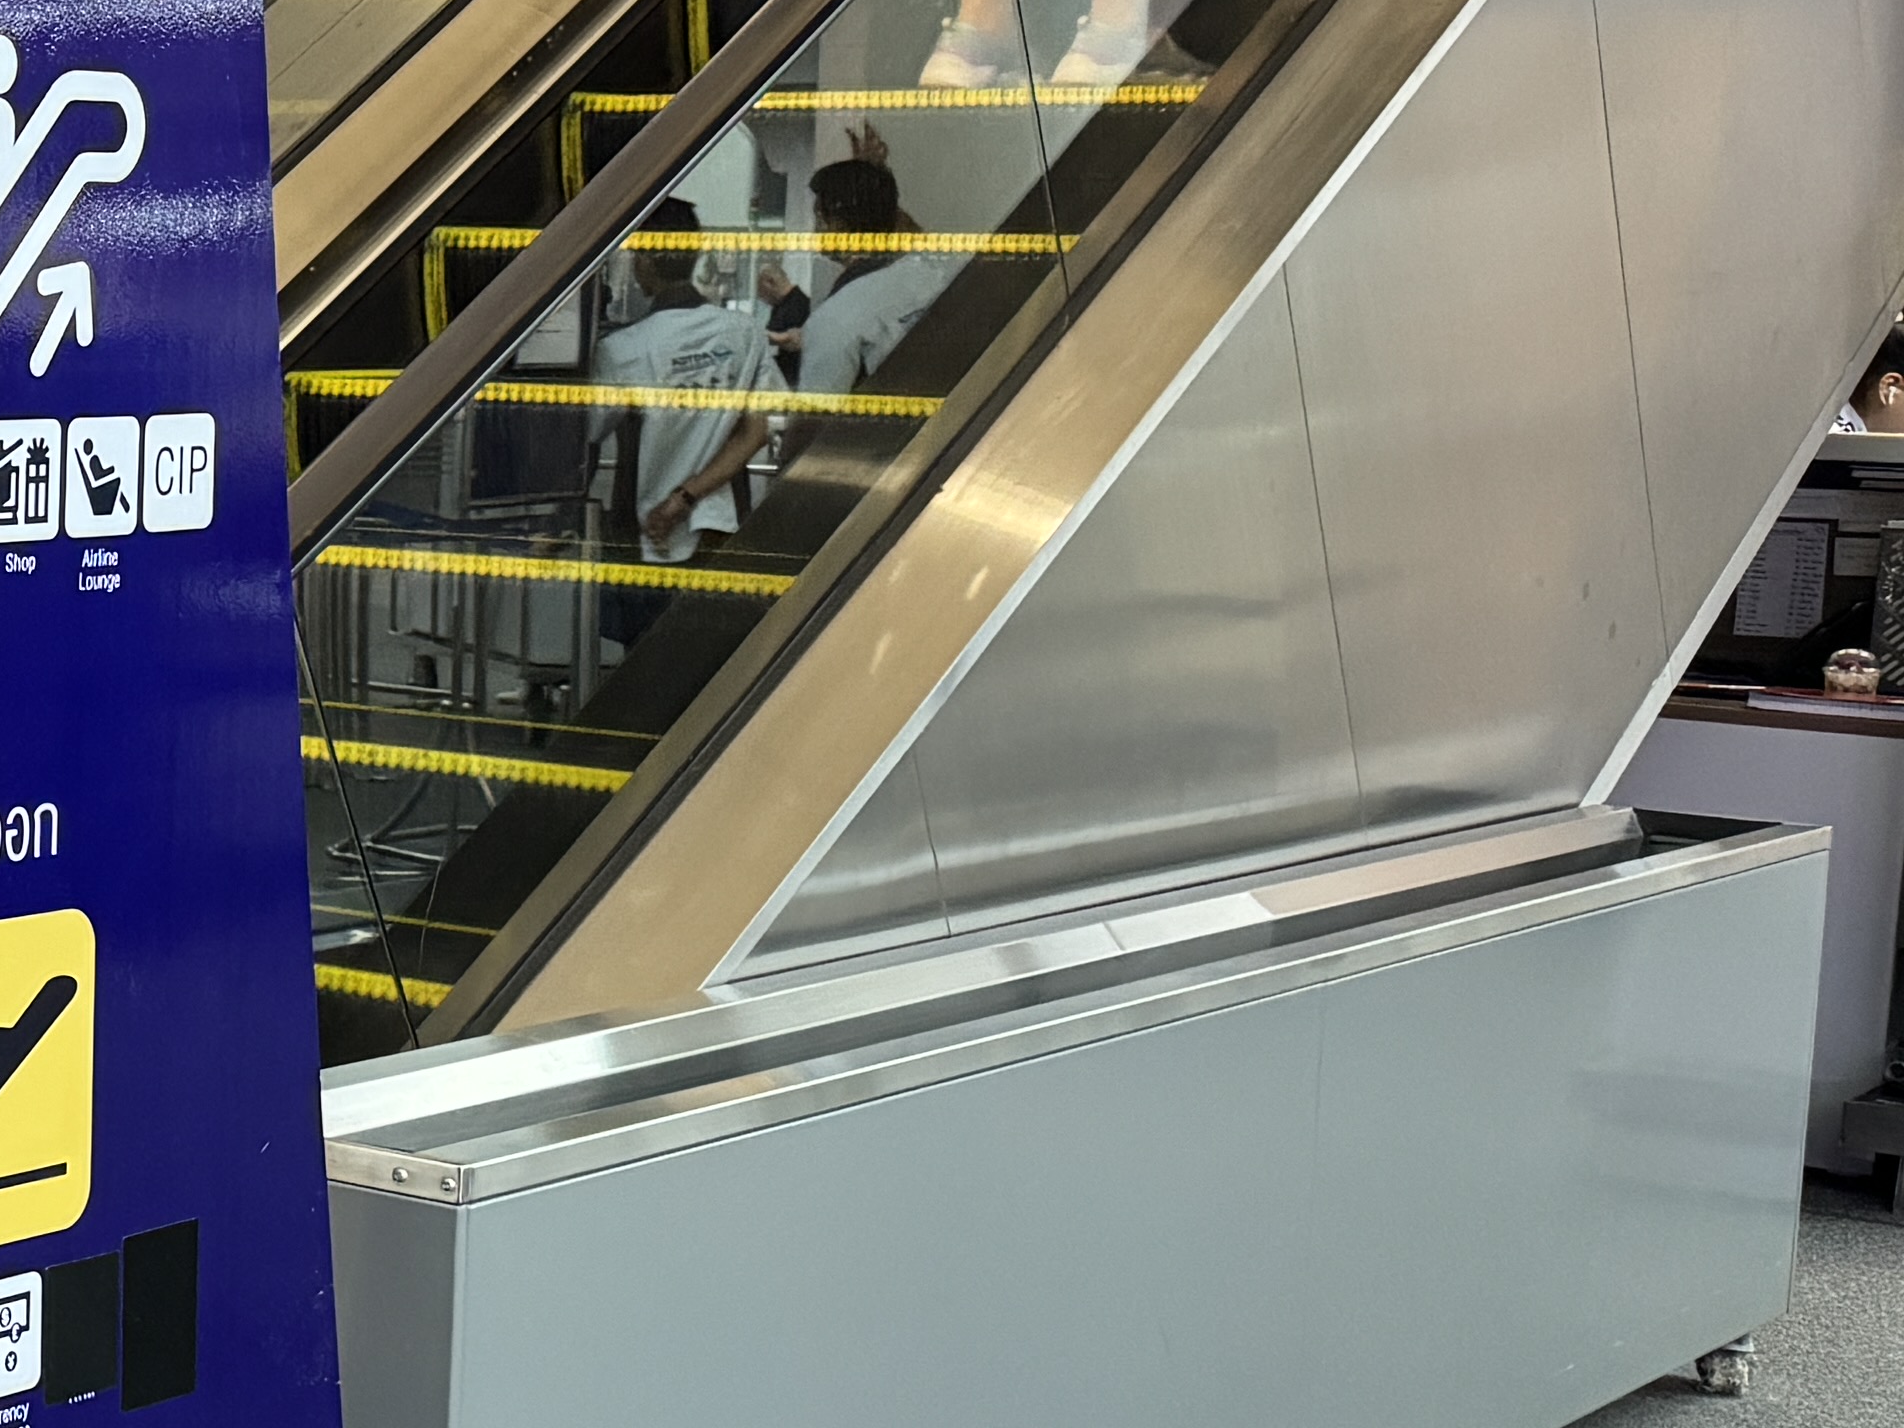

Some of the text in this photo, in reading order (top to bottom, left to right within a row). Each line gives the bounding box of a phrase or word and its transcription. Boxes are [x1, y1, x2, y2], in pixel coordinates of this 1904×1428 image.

[155, 445, 208, 496] CIP
[5, 553, 36, 574] Shop
[82, 548, 119, 568] Airline
[79, 572, 120, 593] Lounge
